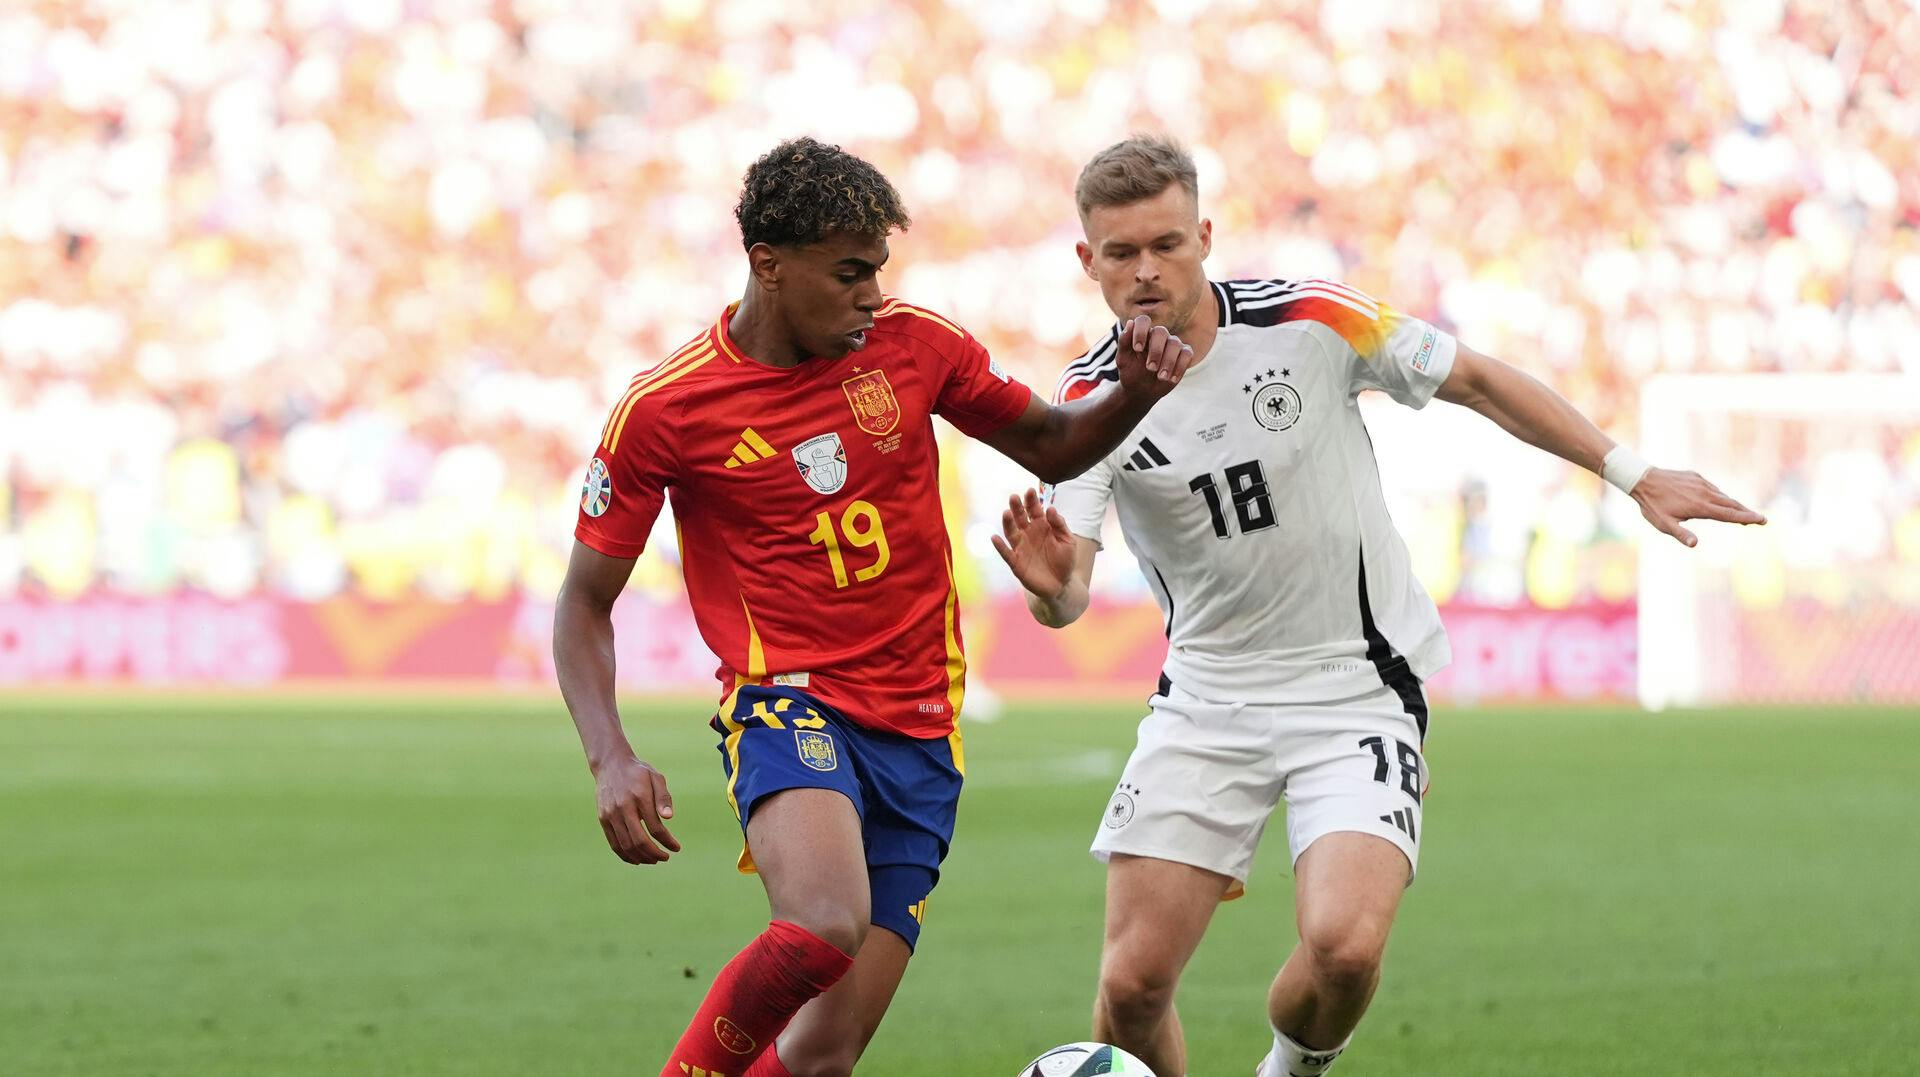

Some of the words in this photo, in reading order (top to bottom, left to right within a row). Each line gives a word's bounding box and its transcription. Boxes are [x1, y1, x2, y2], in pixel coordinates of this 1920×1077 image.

[1189, 459, 1279, 539] 18
[809, 500, 891, 588] 19
[1358, 736, 1421, 808] 18
